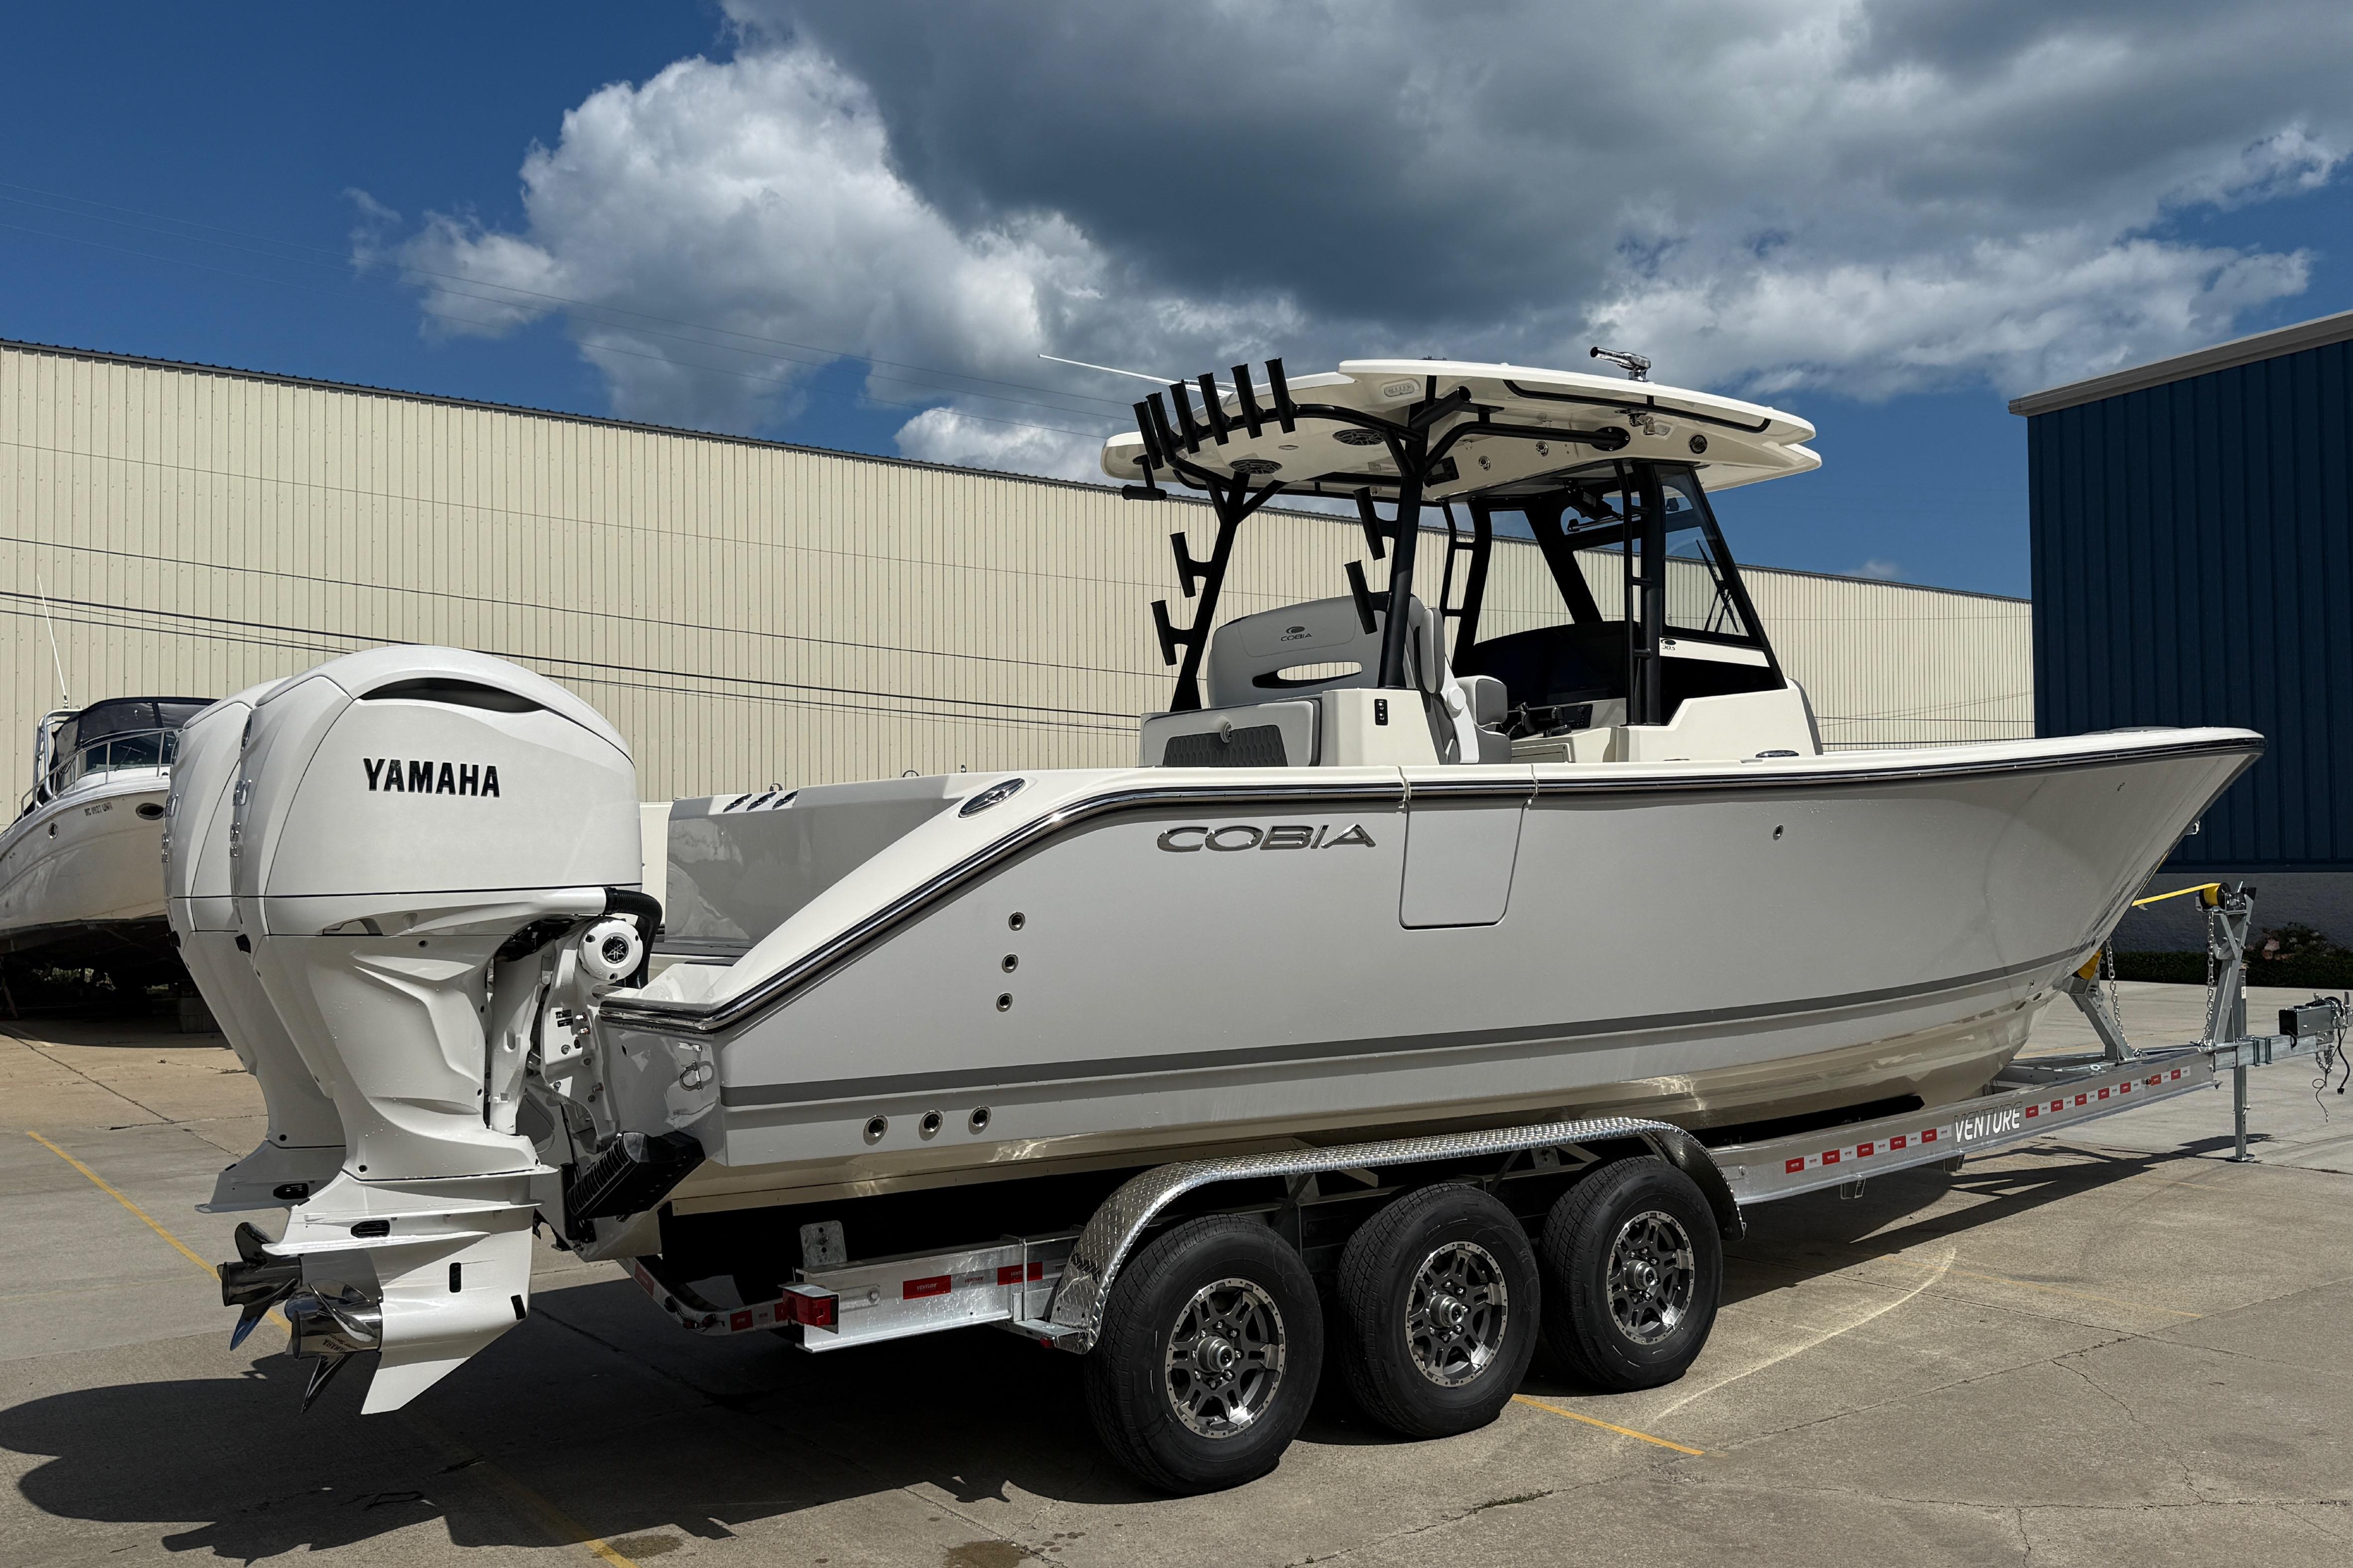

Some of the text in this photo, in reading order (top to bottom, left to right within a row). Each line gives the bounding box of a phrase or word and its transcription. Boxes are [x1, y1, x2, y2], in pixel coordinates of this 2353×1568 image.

[363, 758, 500, 798] YAMAHA
[1157, 823, 1377, 853] COBIA
[1954, 1101, 2022, 1143] VENTURE
